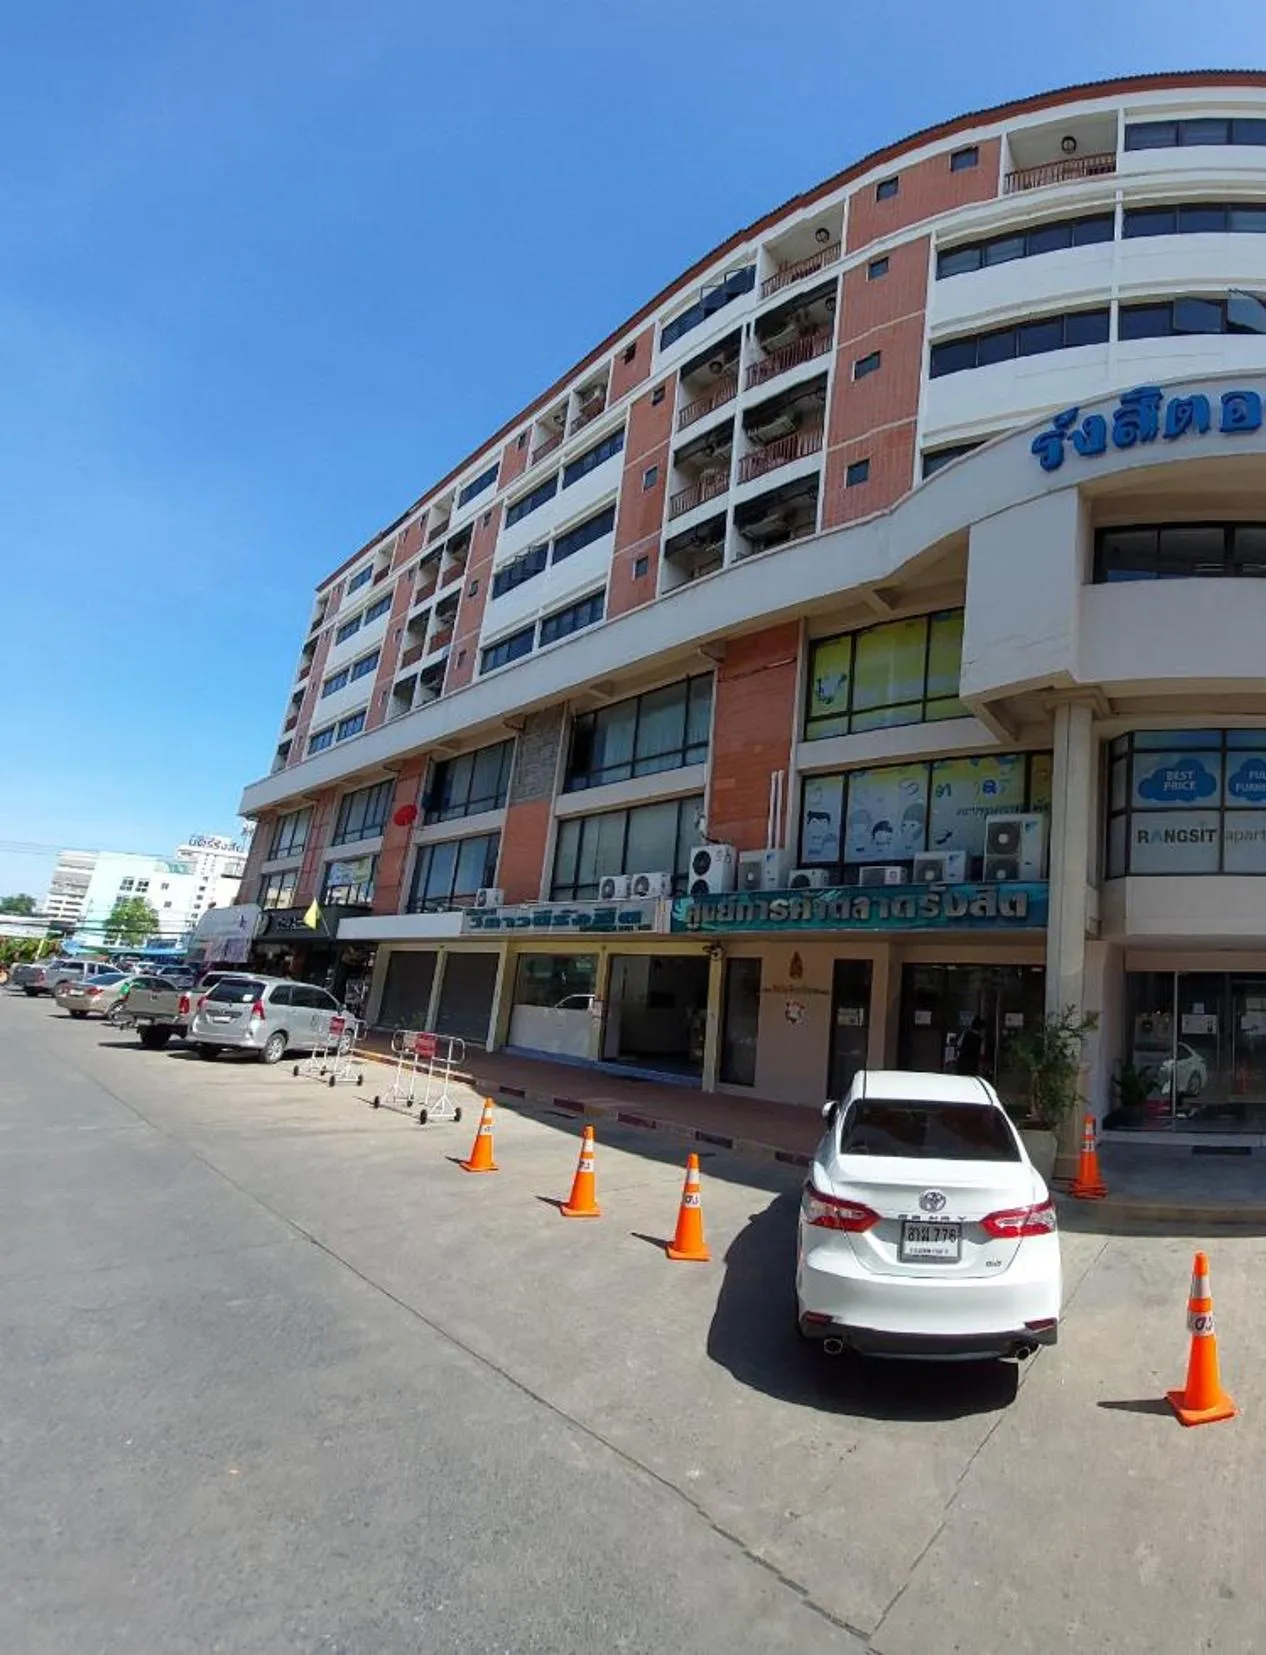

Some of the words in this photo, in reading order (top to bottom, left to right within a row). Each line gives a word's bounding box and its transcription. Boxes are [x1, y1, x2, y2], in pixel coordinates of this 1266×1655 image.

[1164, 770, 1194, 781] BEST
[1162, 780, 1197, 792] PRICE
[1137, 828, 1217, 844] RANGSIT
